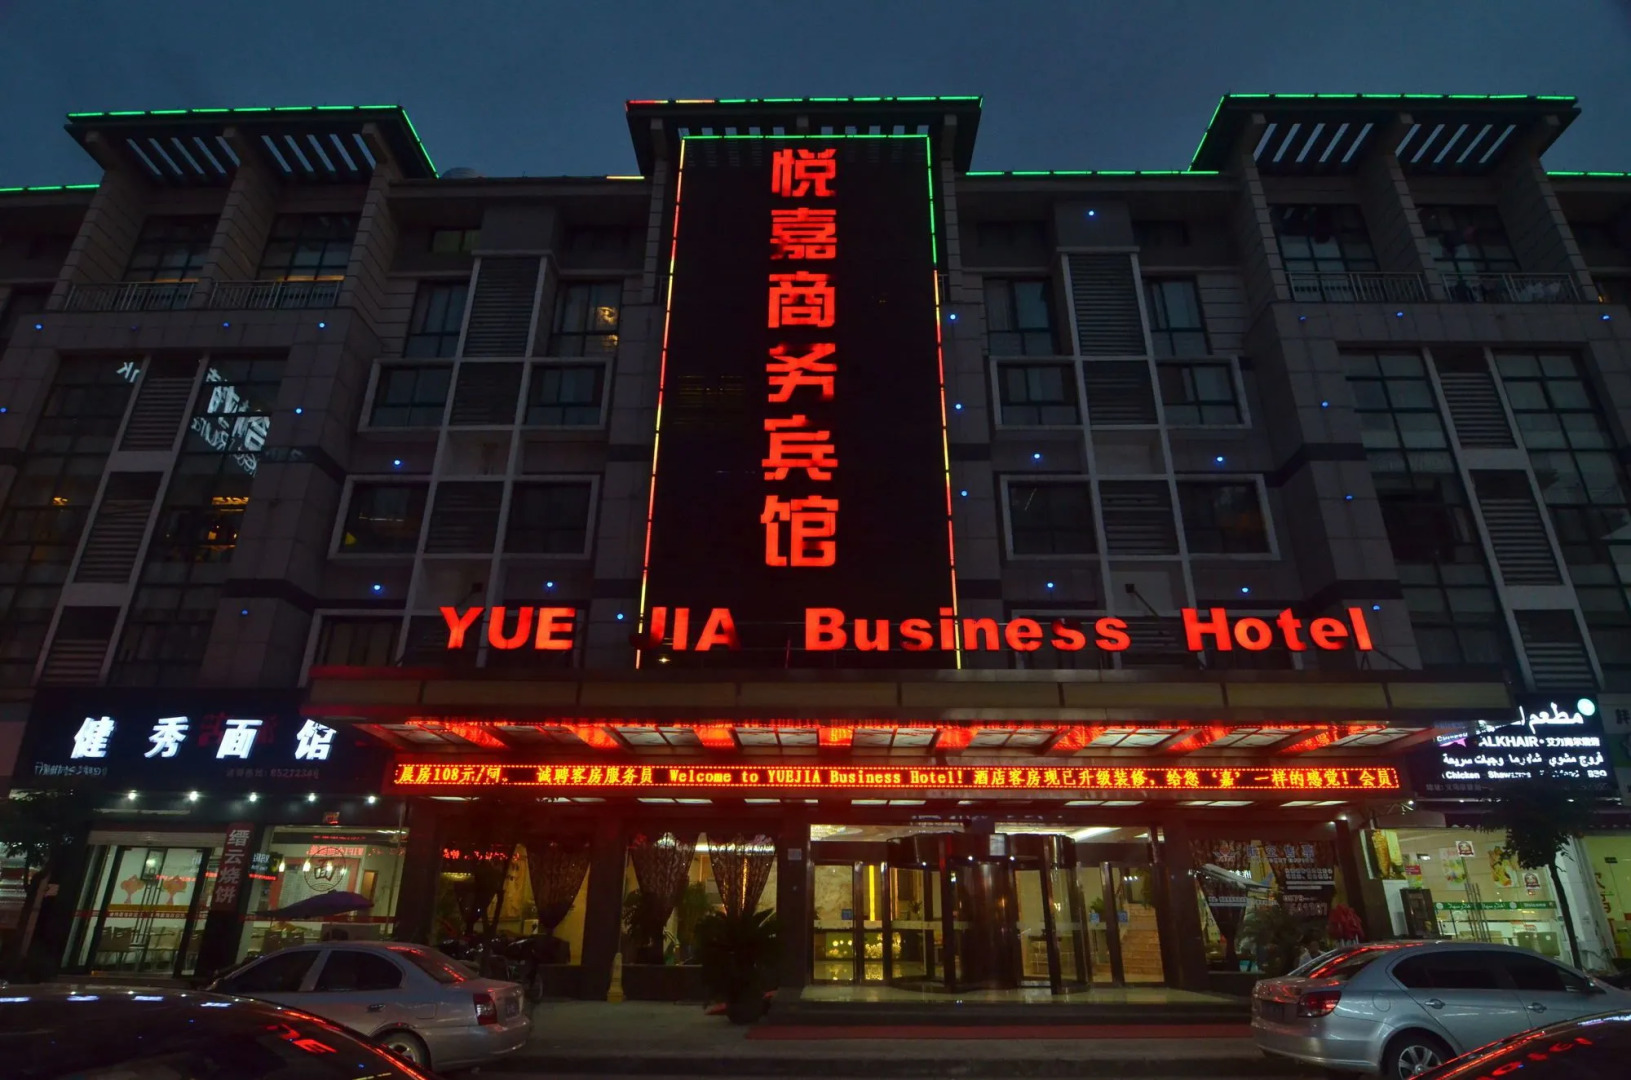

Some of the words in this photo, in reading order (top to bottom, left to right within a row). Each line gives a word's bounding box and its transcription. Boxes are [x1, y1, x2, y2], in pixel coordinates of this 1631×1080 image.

[760, 147, 840, 567] 悦嘉商务宾馆
[440, 606, 575, 651] YUE
[805, 607, 1131, 653] Business
[1183, 607, 1374, 653] Hotel
[70, 716, 338, 760] 健秀面馆
[1529, 702, 1584, 734] مطعم
[1479, 735, 1540, 747] ALKHAIR
[536, 767, 653, 784] 诚聘客房服务员
[669, 769, 731, 784] Welcome
[741, 770, 759, 784] to
[768, 769, 821, 784] YUEJIA
[830, 769, 902, 784] Business
[910, 769, 963, 785] Hotel!
[215, 829, 250, 904] 缙云烧饼
